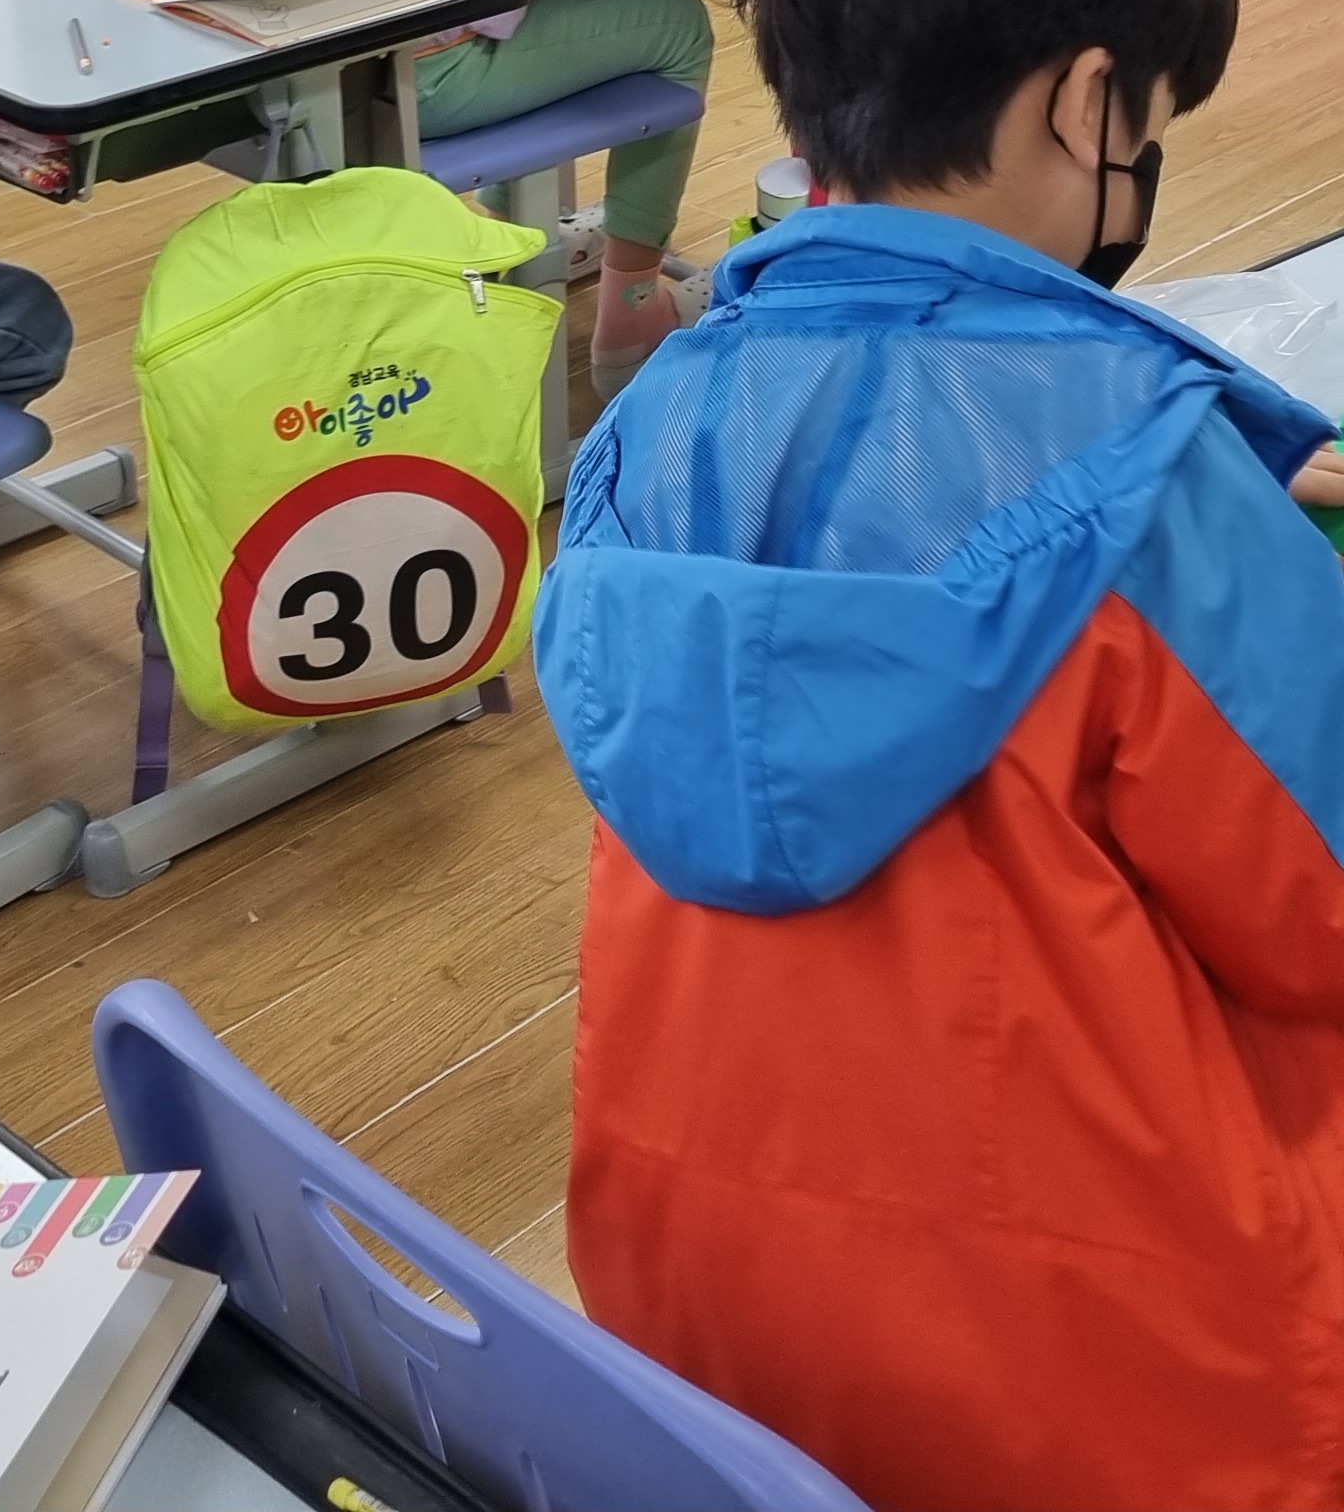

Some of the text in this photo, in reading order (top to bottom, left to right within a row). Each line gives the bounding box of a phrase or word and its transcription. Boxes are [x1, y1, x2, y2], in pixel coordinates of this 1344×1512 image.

[274, 374, 431, 448] 아이좋아
[348, 363, 400, 388] 경남교육
[278, 548, 479, 682] 30
